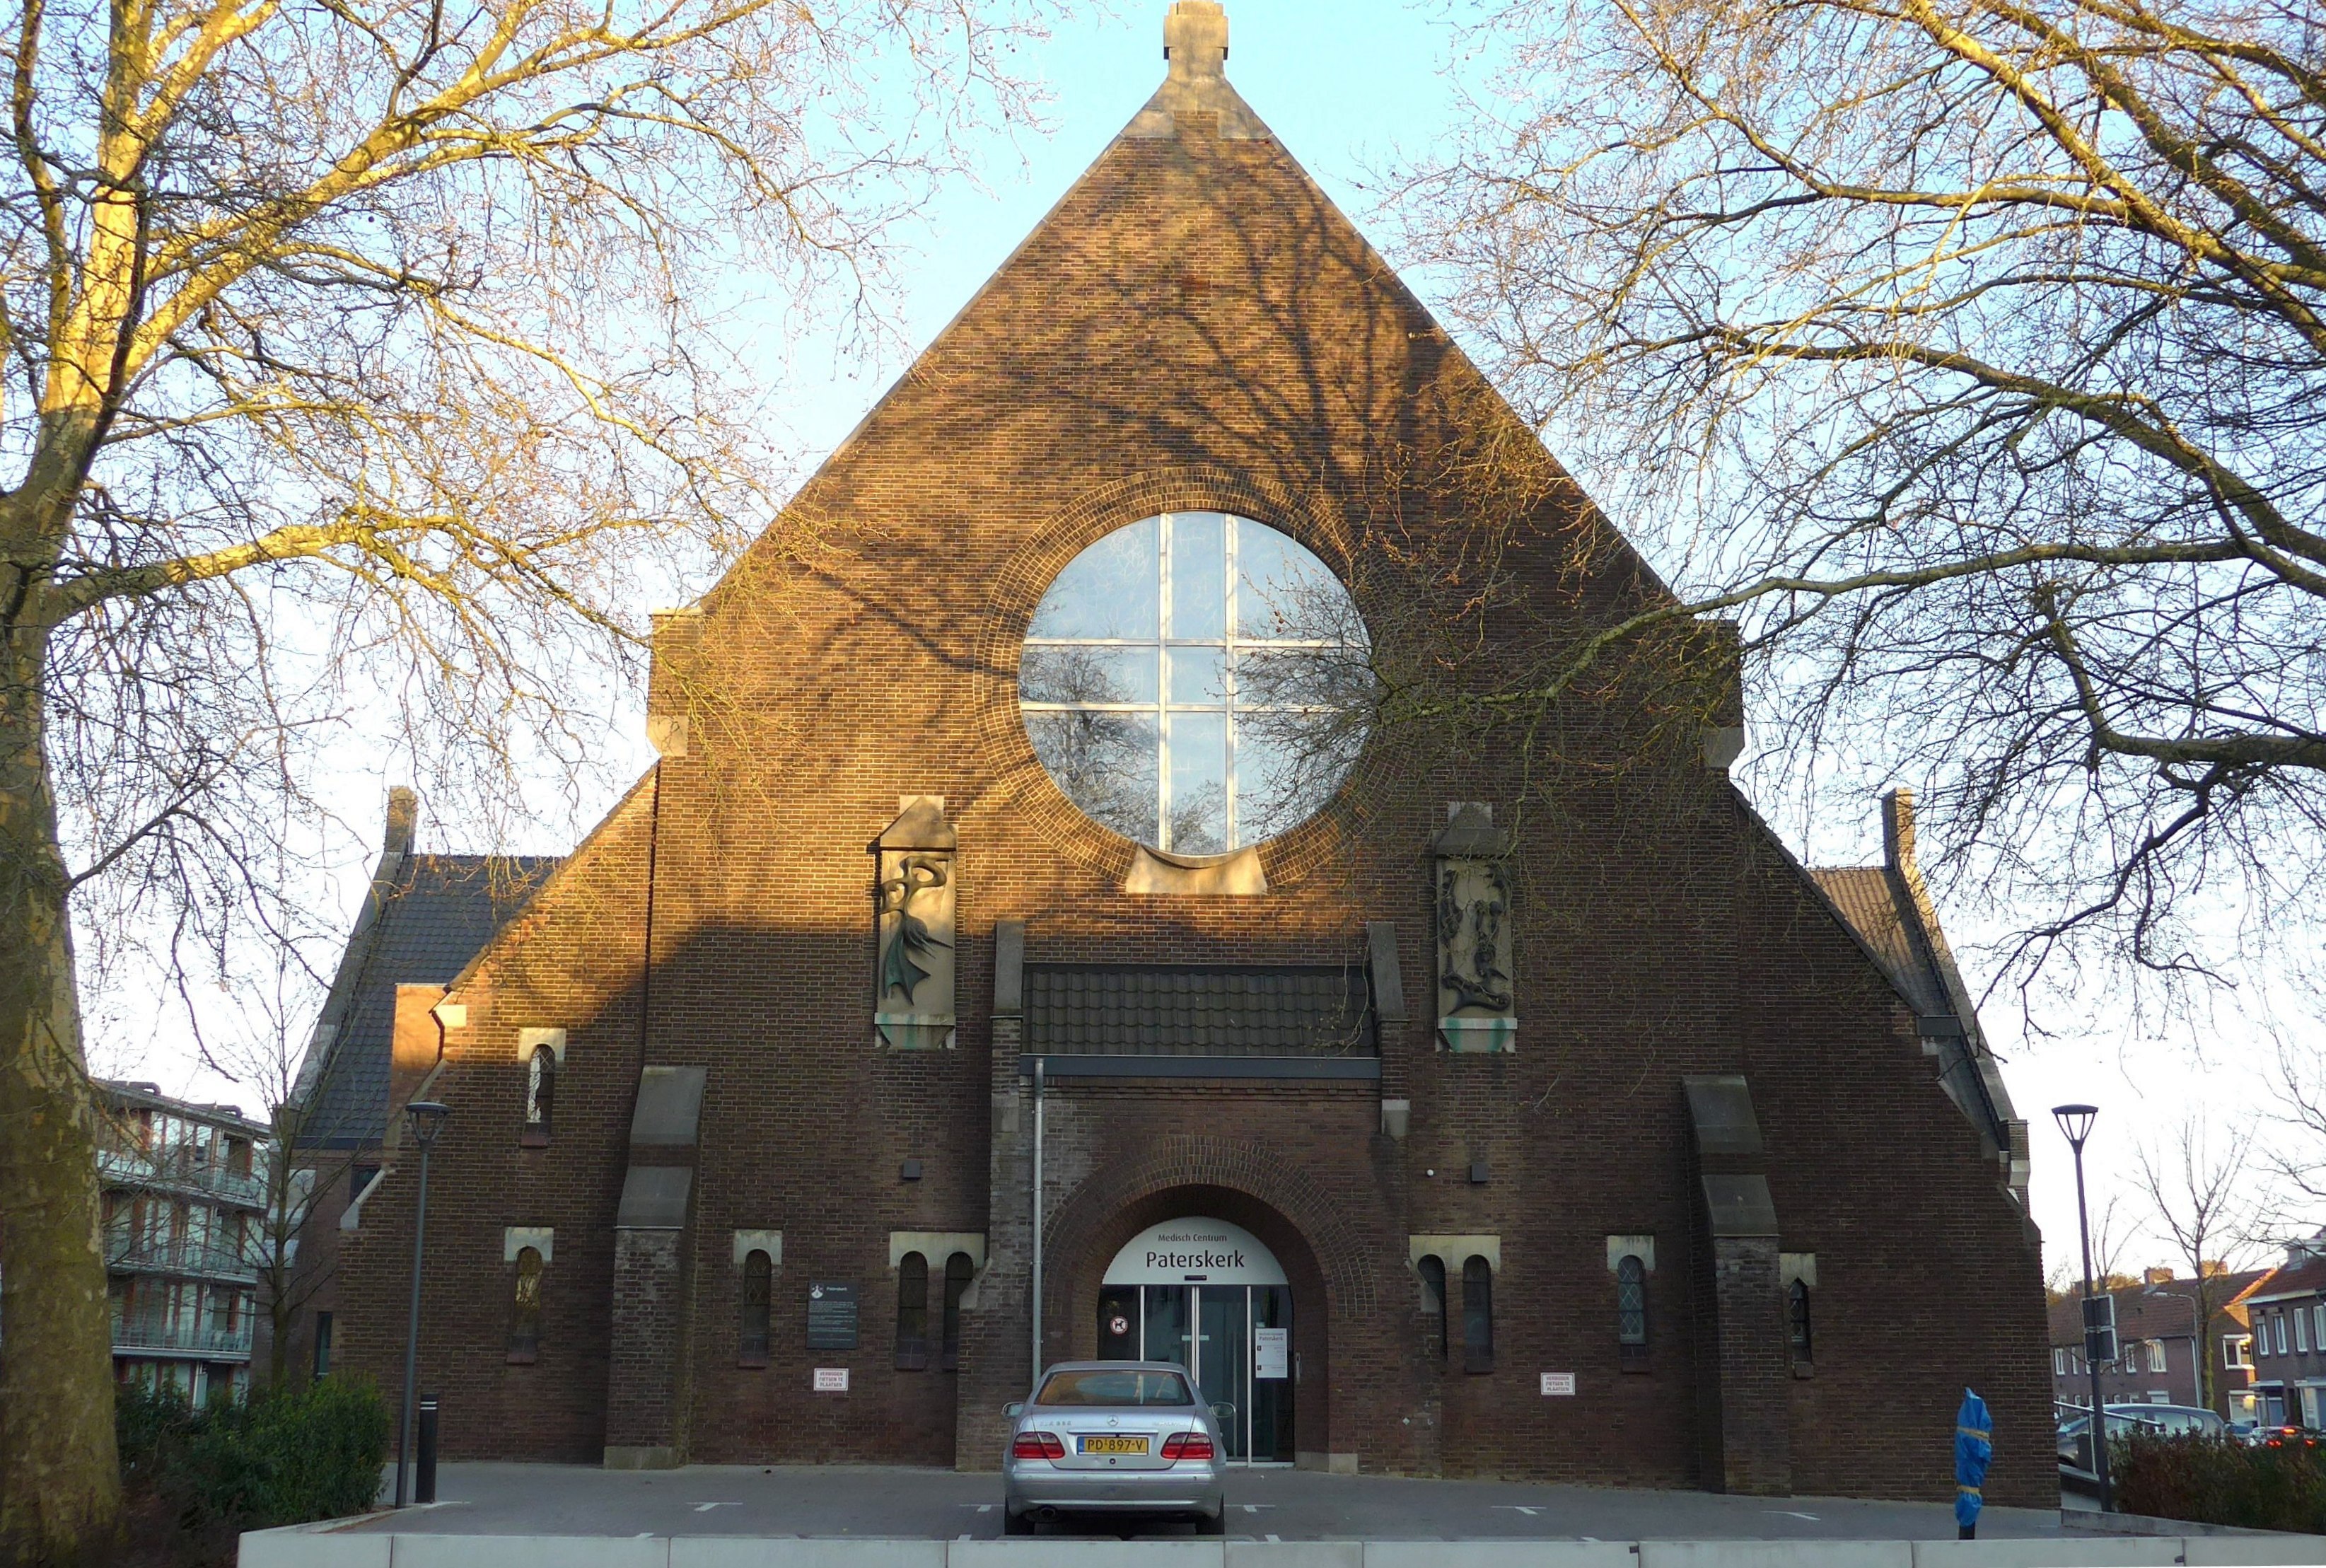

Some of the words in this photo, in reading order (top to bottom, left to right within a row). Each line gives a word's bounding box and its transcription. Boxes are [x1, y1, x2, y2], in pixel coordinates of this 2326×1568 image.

[1158, 1233, 1191, 1242] Medisch
[1193, 1233, 1227, 1242] Centrum
[1146, 1250, 1245, 1267] Paterskerk
